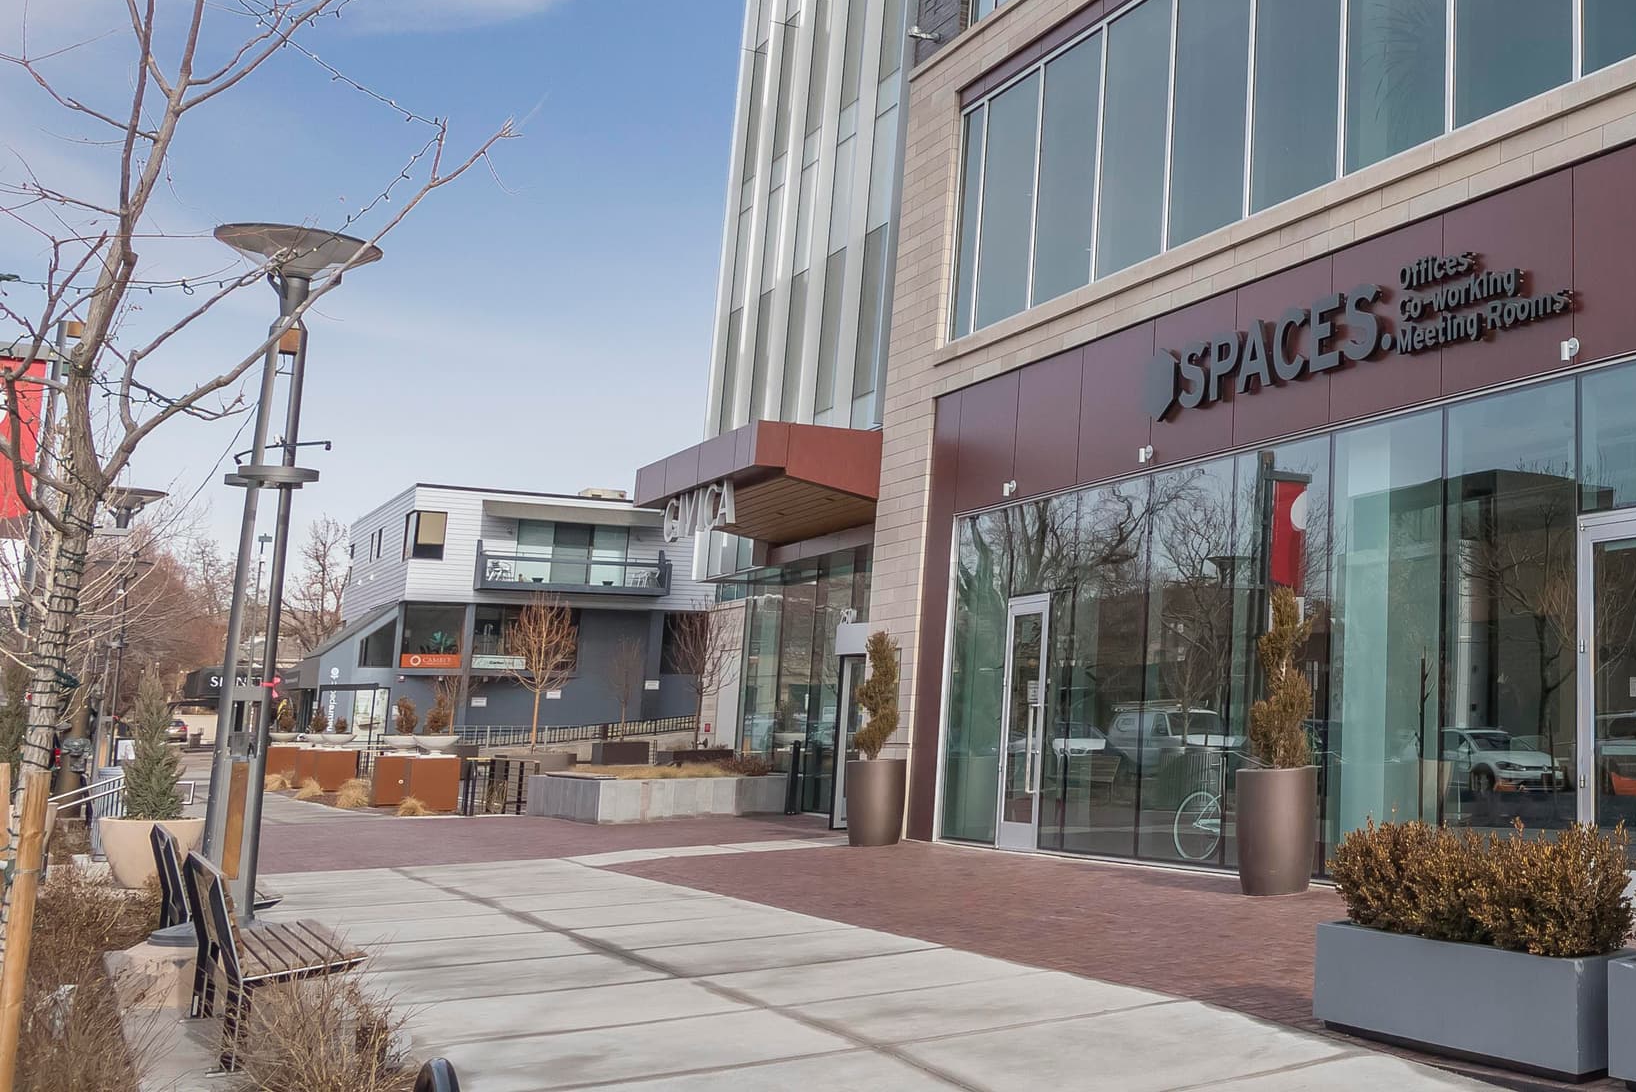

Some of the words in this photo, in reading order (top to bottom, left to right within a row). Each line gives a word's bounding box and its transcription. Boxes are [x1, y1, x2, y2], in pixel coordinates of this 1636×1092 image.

[1399, 252, 1474, 290] Offices
[1399, 268, 1522, 322] Co-working
[1396, 311, 1483, 355] Meeting
[1486, 290, 1572, 330] Rooms
[663, 478, 736, 543] CIVICA
